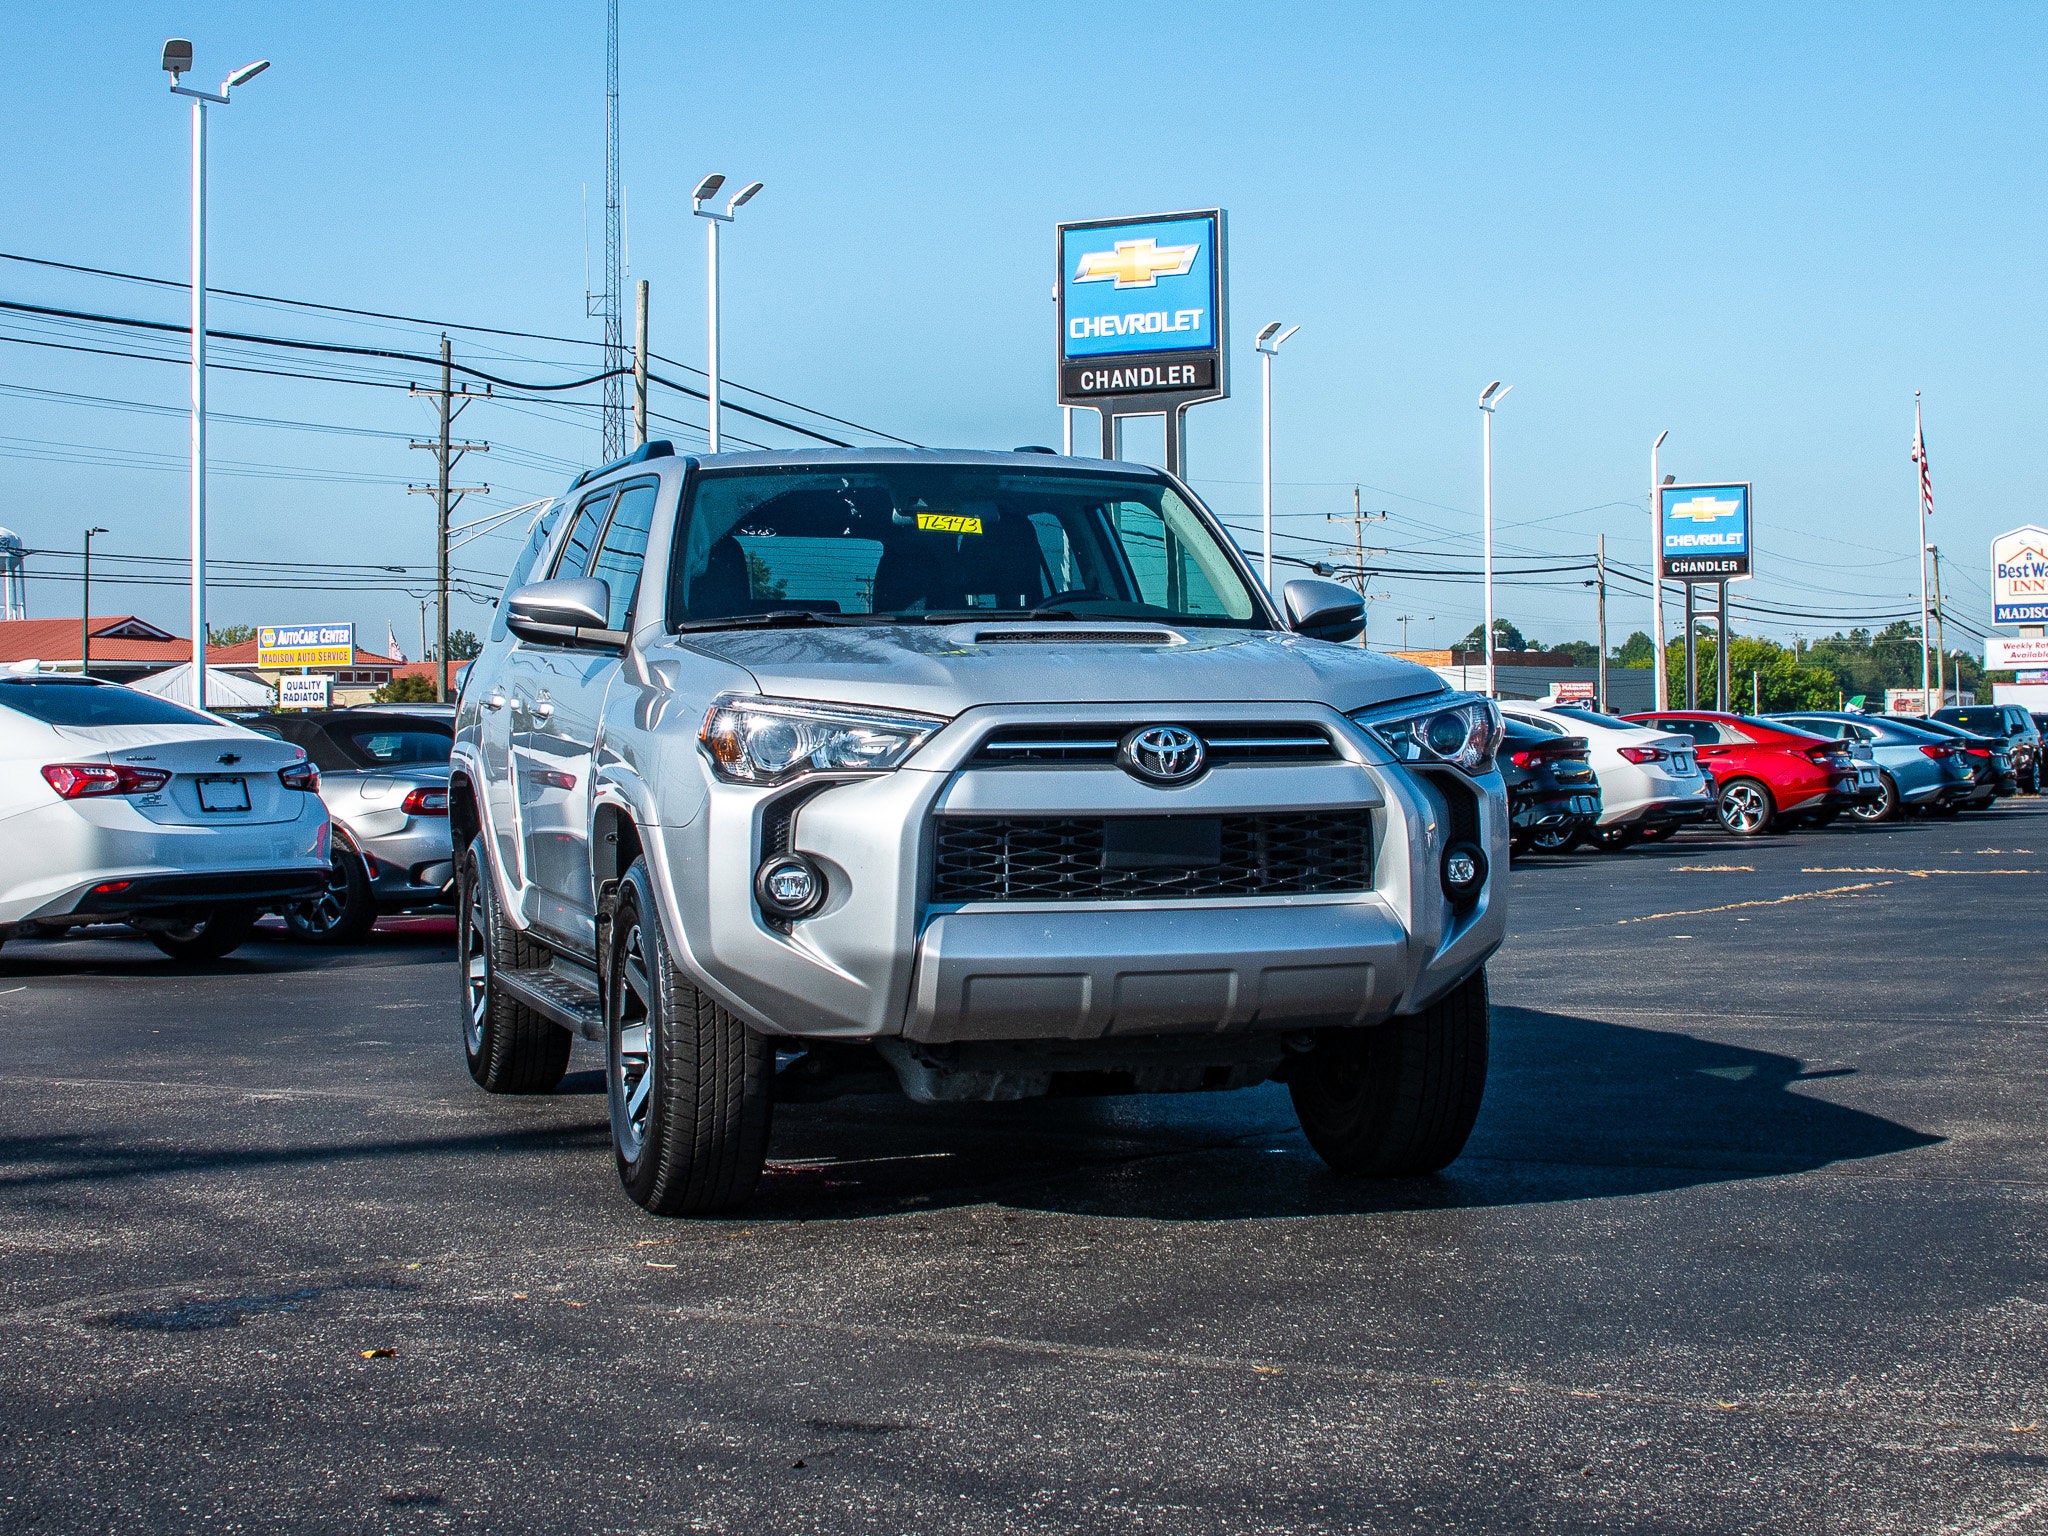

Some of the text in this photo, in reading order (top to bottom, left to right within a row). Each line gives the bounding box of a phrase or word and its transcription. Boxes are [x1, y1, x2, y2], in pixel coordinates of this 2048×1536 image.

[1069, 309, 1203, 339] CHEVROLET
[1080, 364, 1196, 391] CHANDLER
[1665, 532, 1744, 547] CHEVROLET
[1671, 560, 1738, 573] CHANDLER
[1998, 563, 2030, 578] Best
[2013, 579, 2046, 592] INN
[2003, 642, 2032, 650] Weekly
[286, 681, 321, 690] QUALITY
[283, 692, 325, 702] RADIATOR
